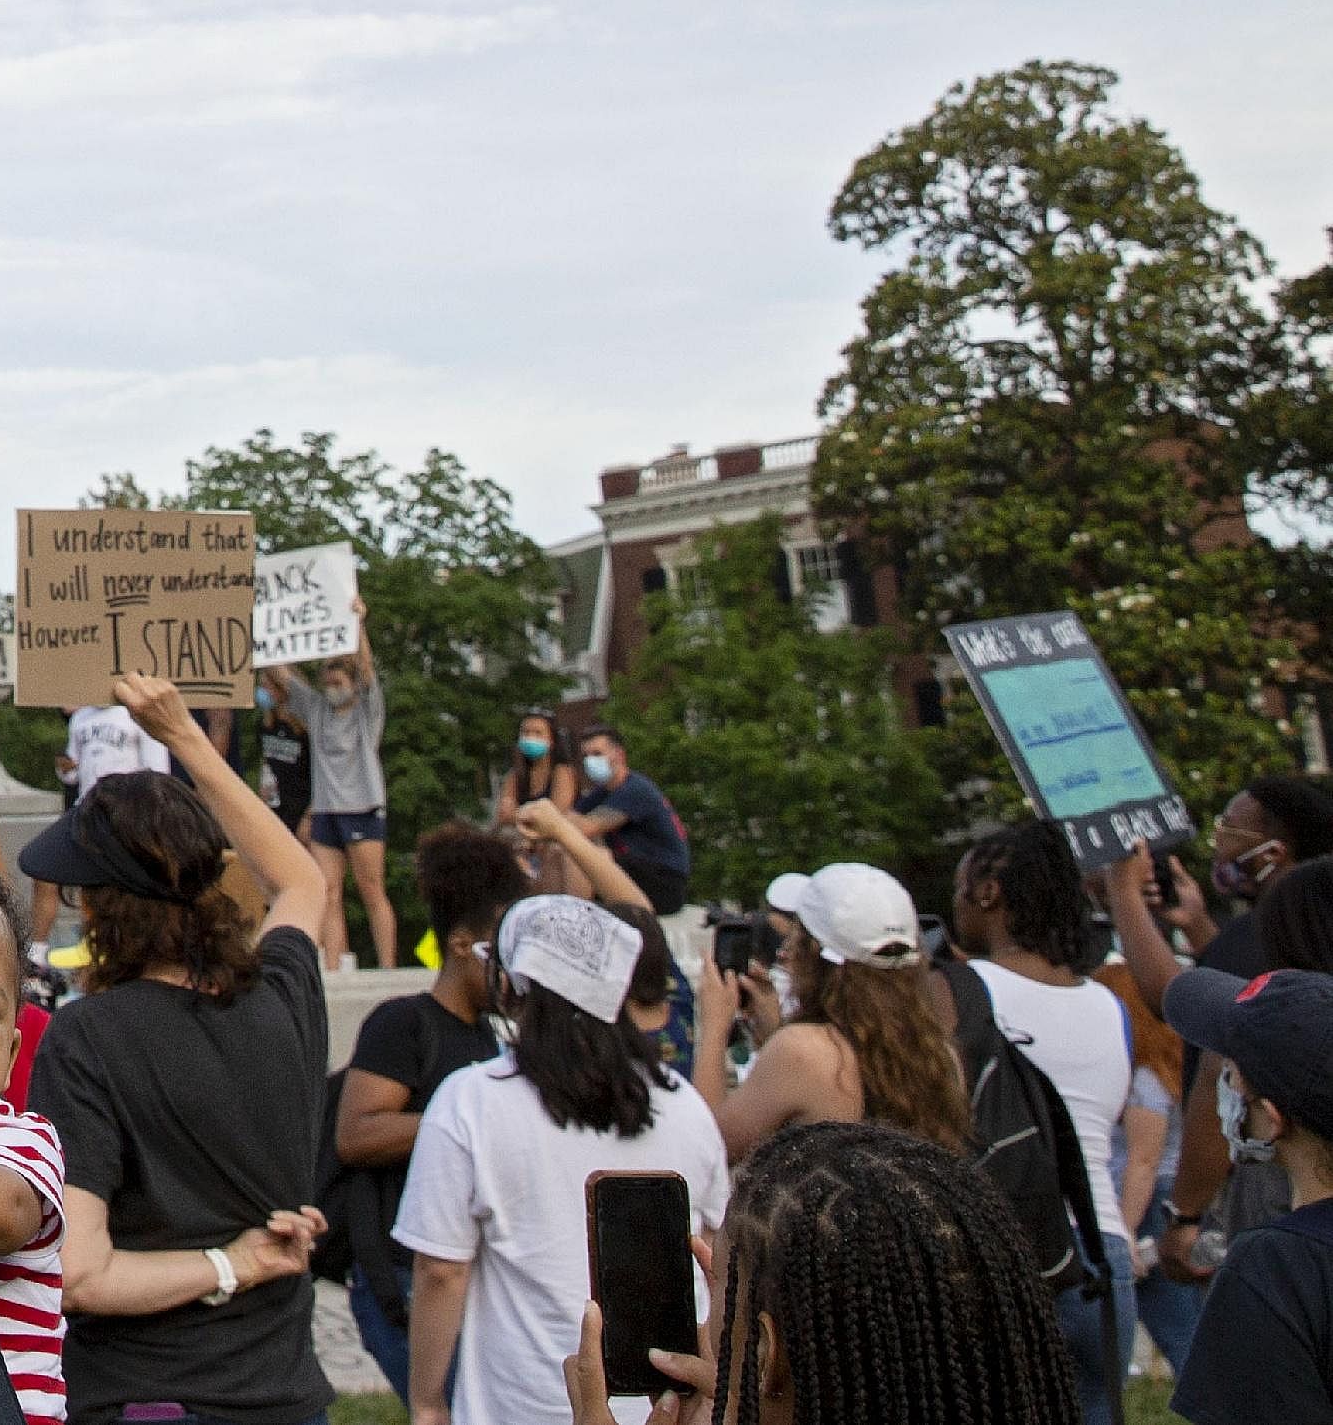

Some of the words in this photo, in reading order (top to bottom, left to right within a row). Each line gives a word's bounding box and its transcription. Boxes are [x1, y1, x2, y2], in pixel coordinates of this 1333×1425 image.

[26, 513, 34, 558] I
[53, 518, 192, 554] understand
[201, 520, 248, 552] that
[23, 567, 32, 608] I
[50, 566, 89, 602] will
[103, 571, 154, 597] never
[105, 611, 126, 676] I
